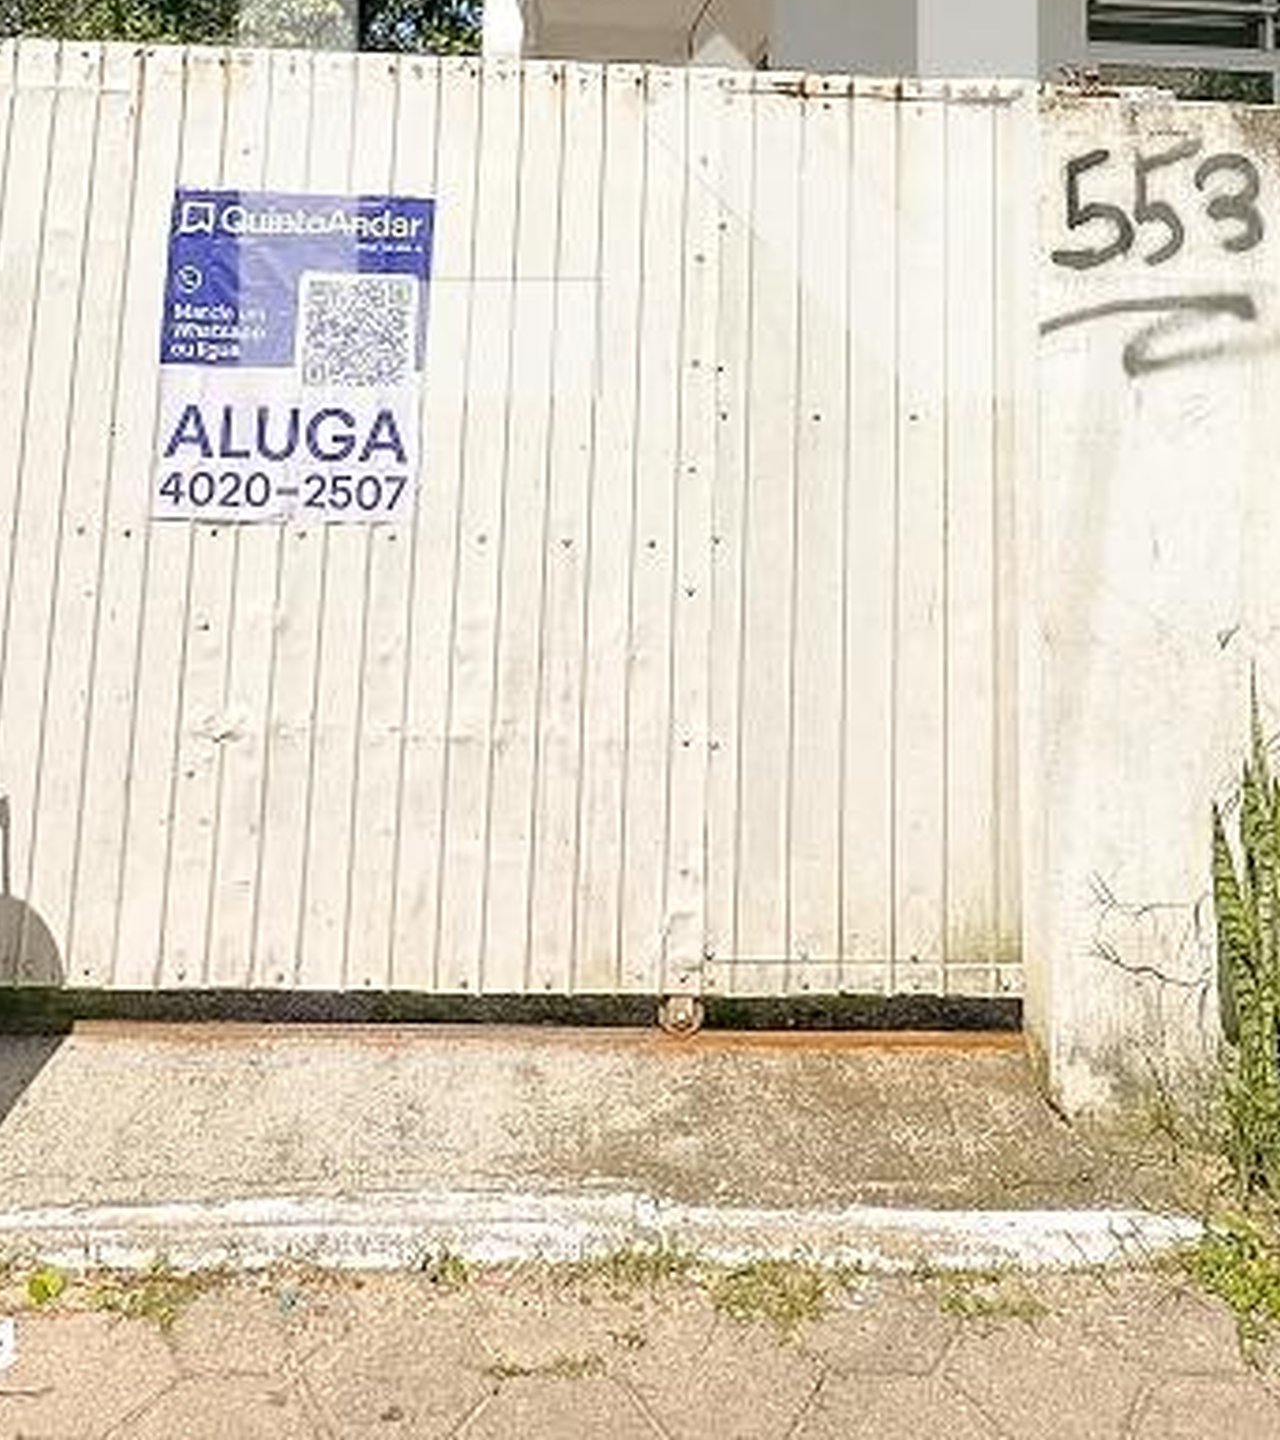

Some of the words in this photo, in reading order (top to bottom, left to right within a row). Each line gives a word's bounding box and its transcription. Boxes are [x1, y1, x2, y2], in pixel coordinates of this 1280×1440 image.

[221, 205, 424, 238] QuintoAndar
[1051, 139, 1265, 271] 553
[163, 404, 408, 463] ALUGA
[159, 471, 409, 511] 4020-2507
